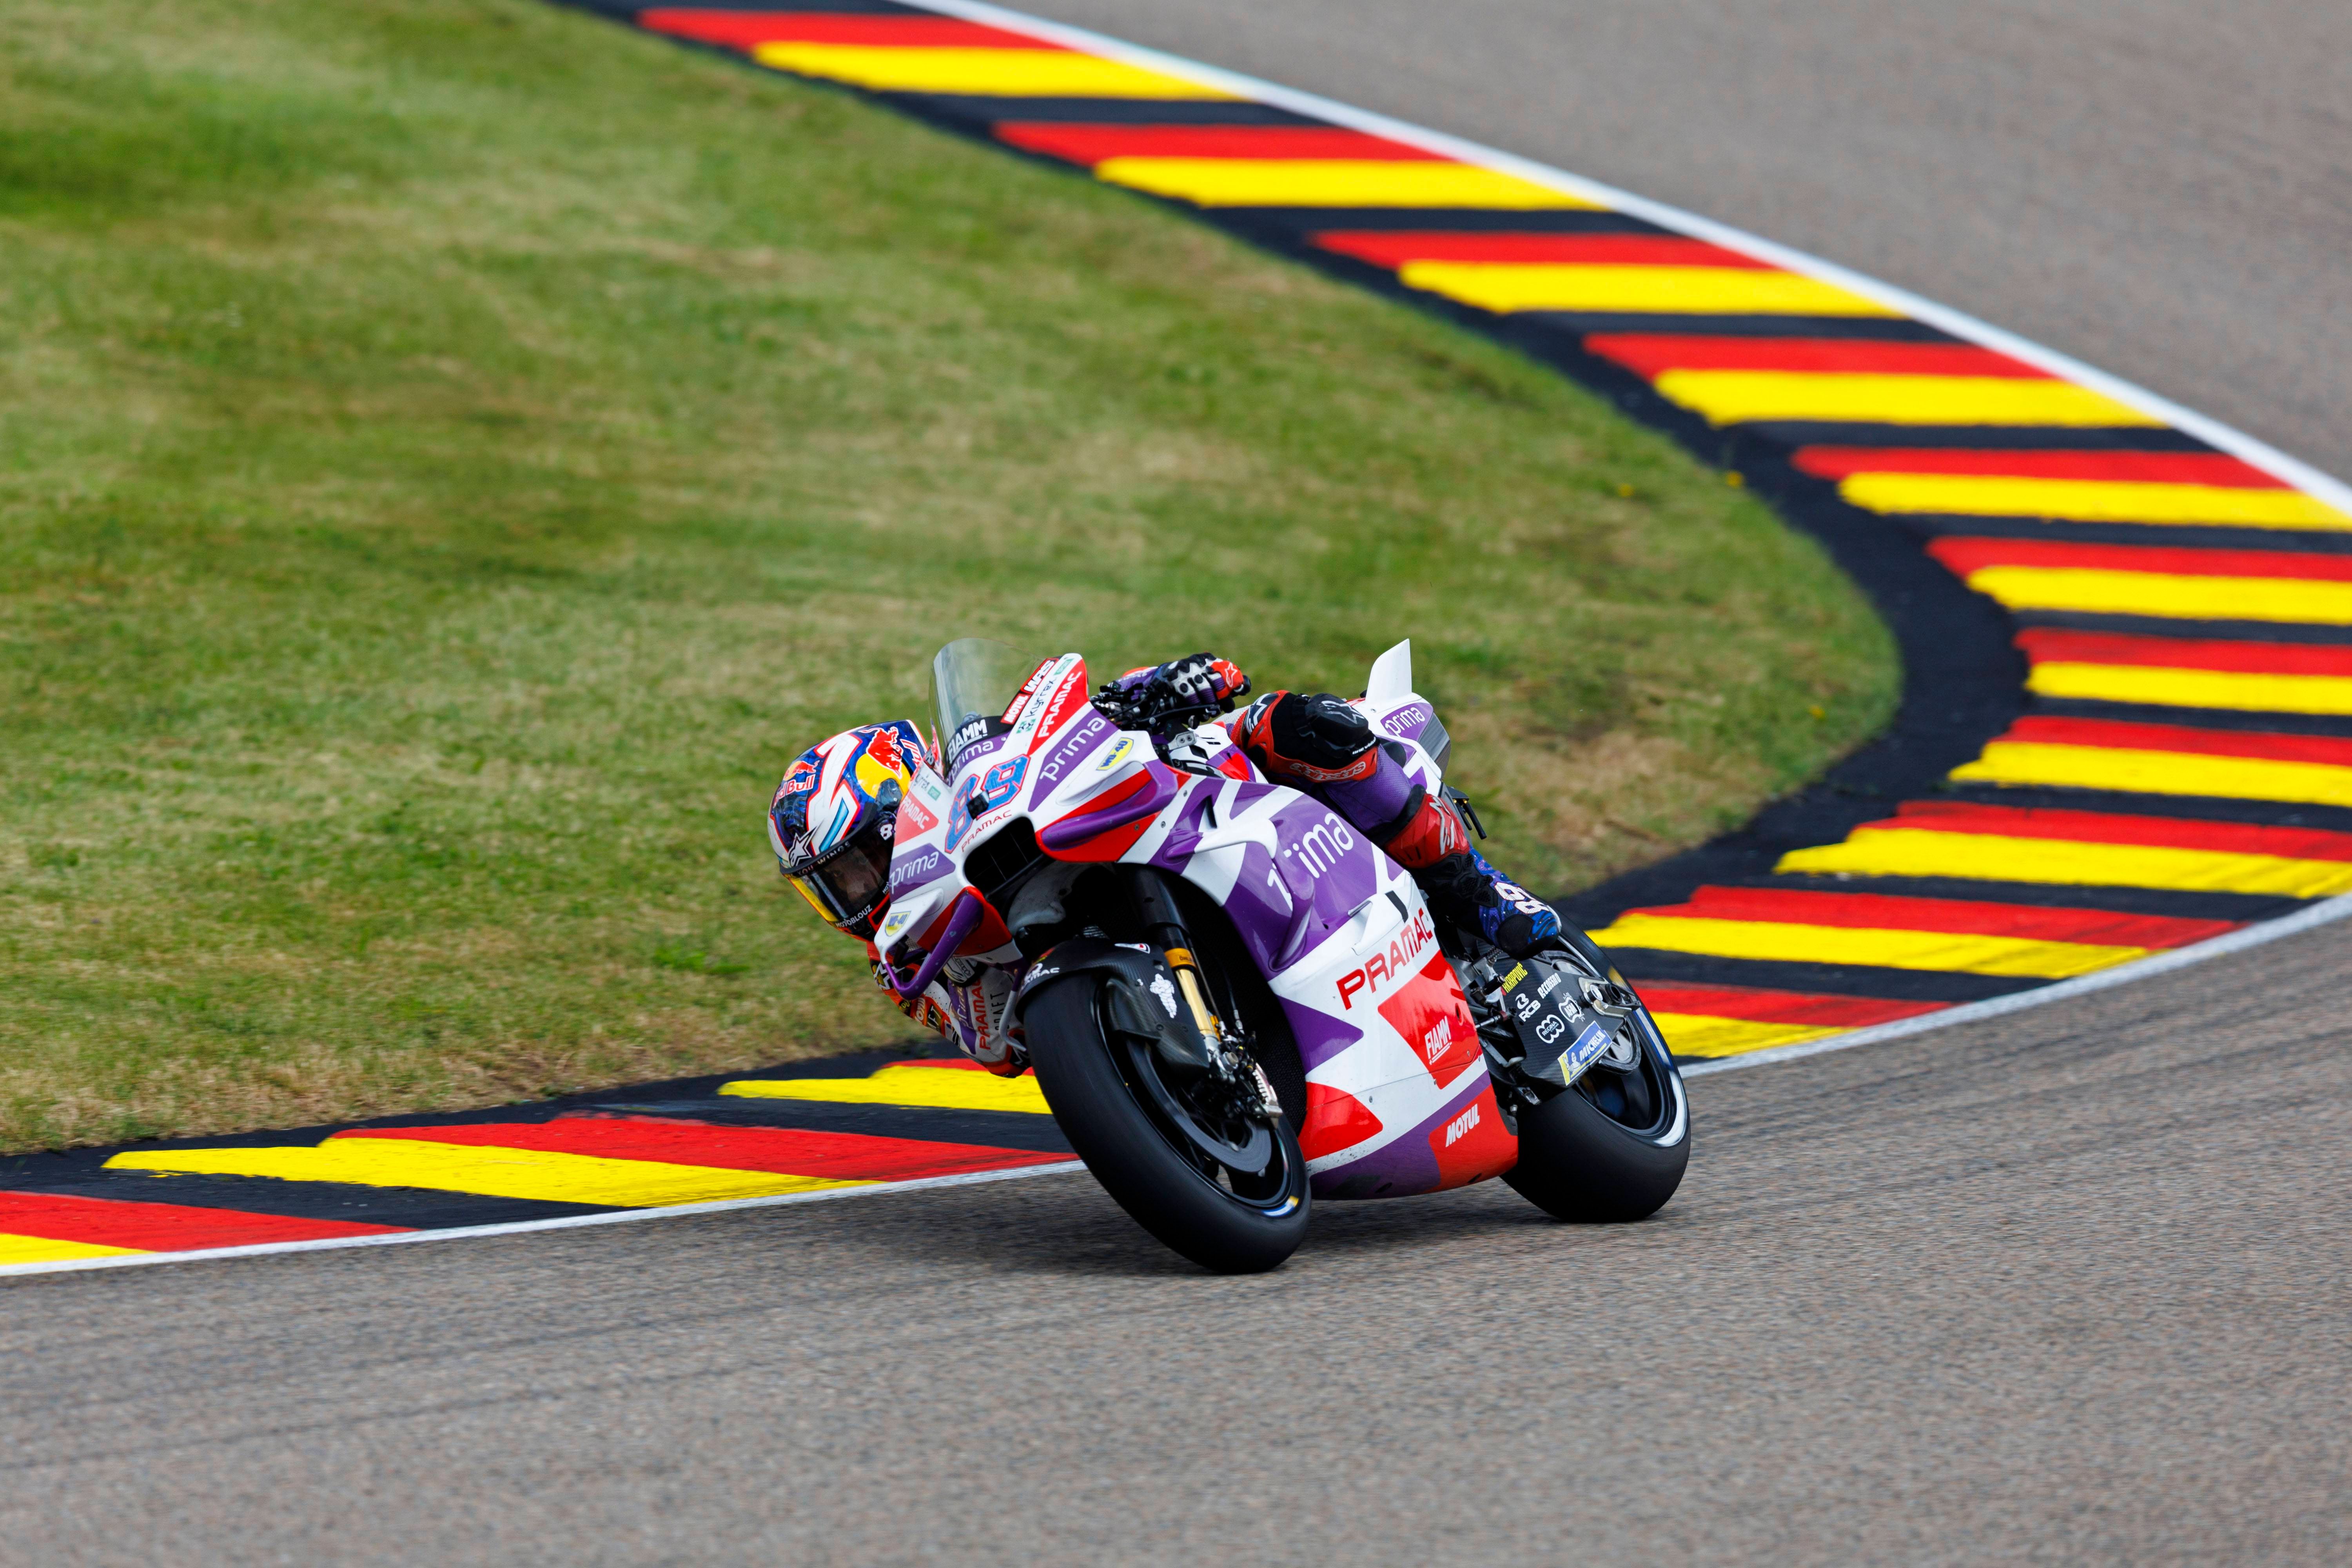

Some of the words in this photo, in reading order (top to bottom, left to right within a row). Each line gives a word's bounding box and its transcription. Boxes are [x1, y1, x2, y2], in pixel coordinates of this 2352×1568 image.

[1024, 660, 1055, 692] WRS
[1004, 695, 1029, 723] MOTUL
[1037, 671, 1082, 738] PRAMAC
[1385, 707, 1425, 737] prima
[947, 719, 987, 764] FIAMM
[948, 740, 994, 786] prima
[1039, 717, 1106, 781] prima
[944, 753, 1031, 854] 89
[961, 809, 1012, 853] PRAMAC
[889, 851, 939, 895] prima
[835, 904, 873, 927] MOTOBLOUZ
[1336, 907, 1433, 1011] PRAMAC
[1519, 1000, 1541, 1022] RCB
[1542, 1021, 1557, 1036] REGINA
[1424, 1015, 1451, 1060] FIAMM
[1579, 1029, 1606, 1062] MICHELIN
[1445, 1103, 1480, 1148] MOTUL
